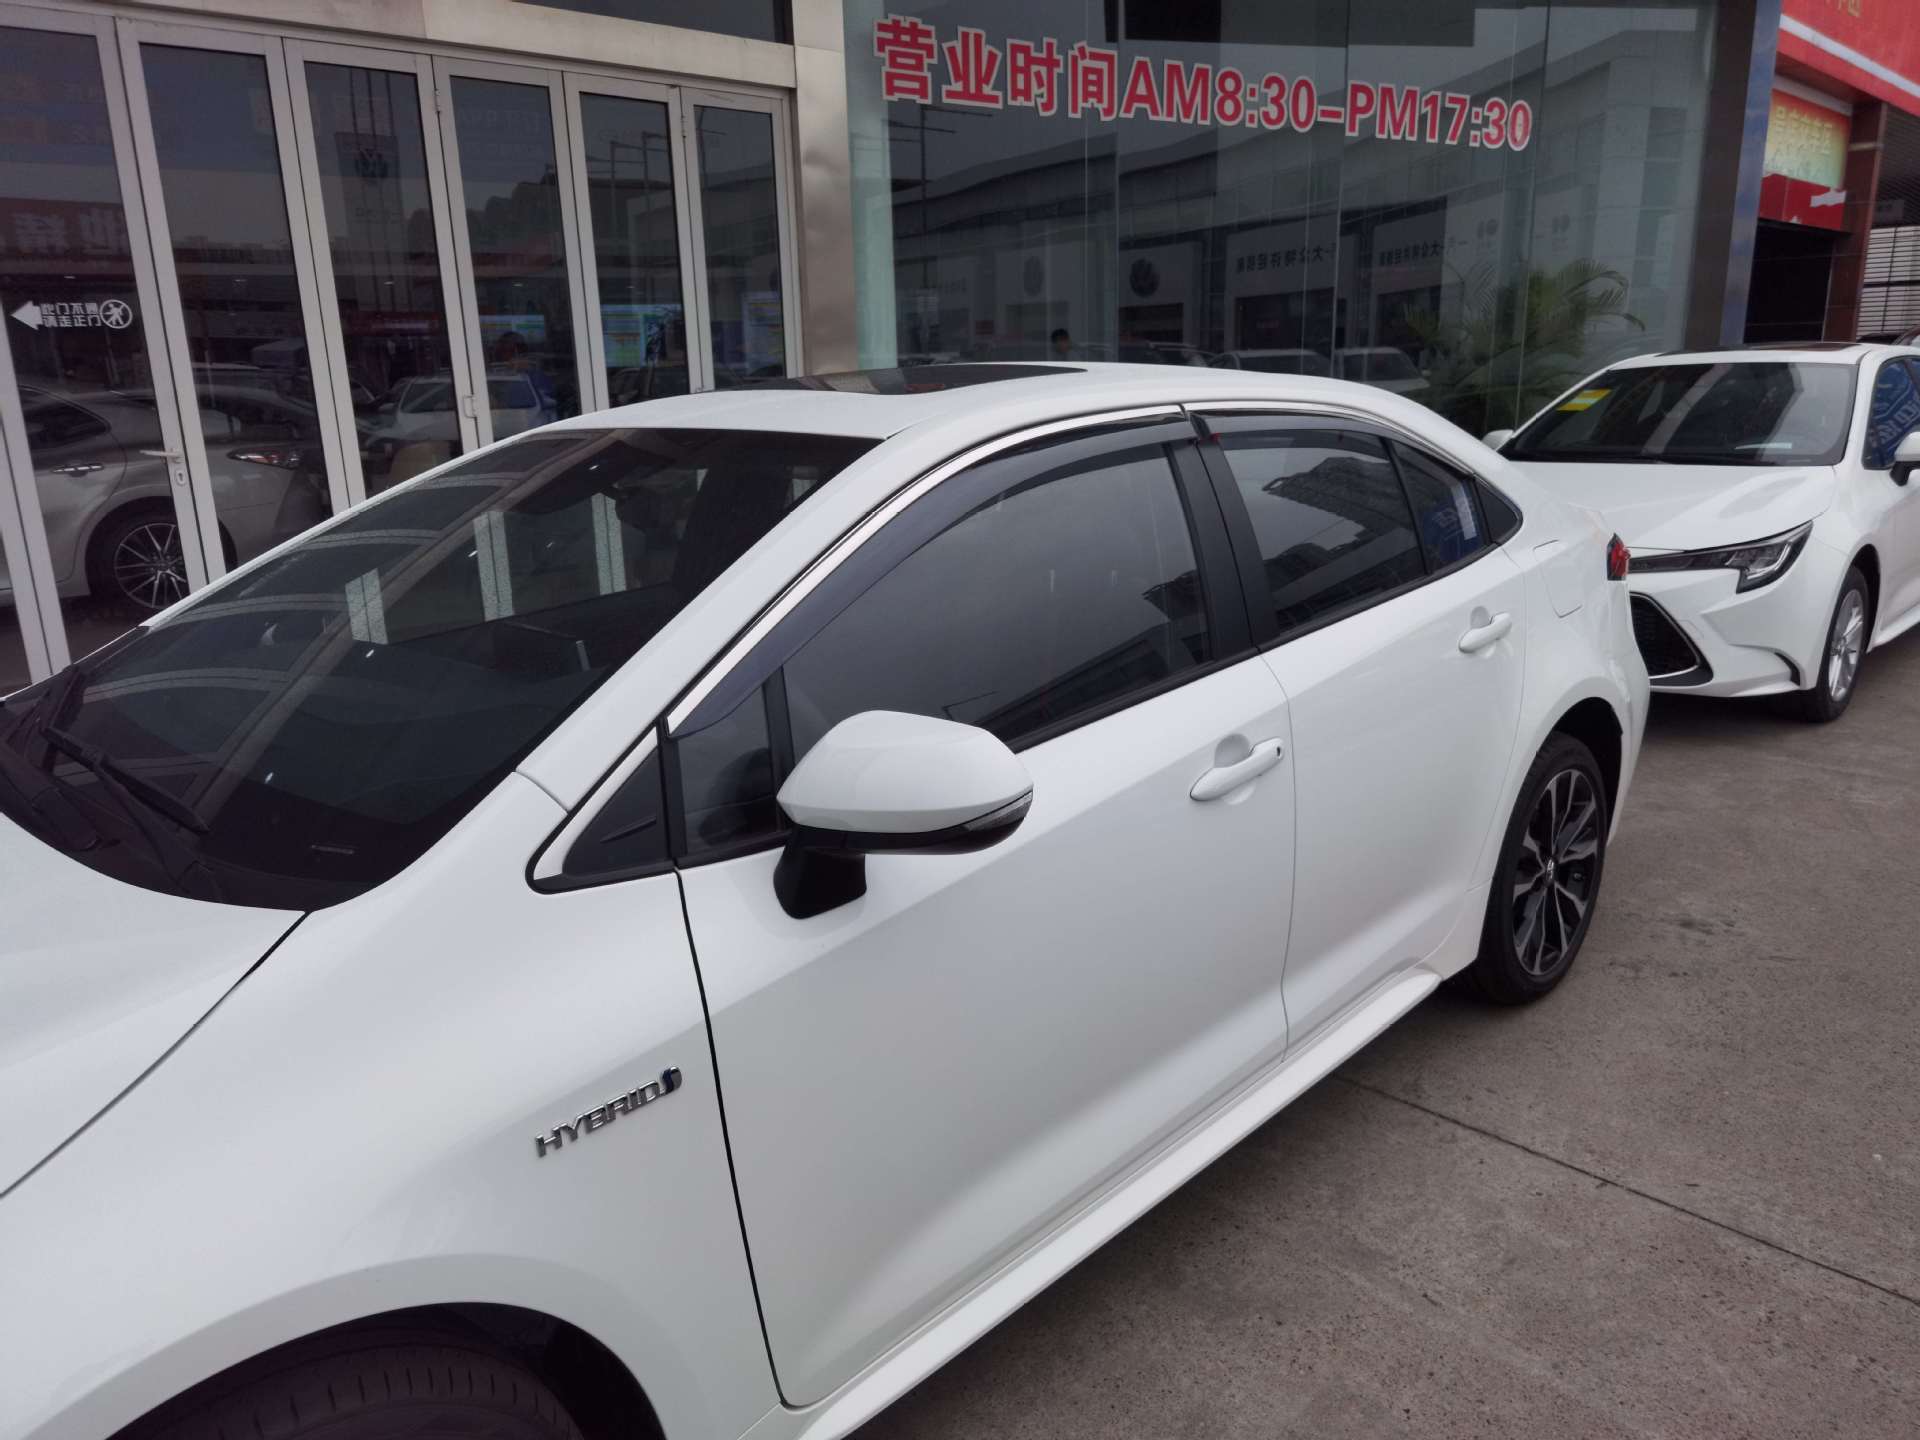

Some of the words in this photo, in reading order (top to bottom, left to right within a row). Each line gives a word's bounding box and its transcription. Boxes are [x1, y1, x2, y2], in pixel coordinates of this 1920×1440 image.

[42, 315, 102, 328] 请走正门
[534, 1080, 660, 1158] HYBRID
